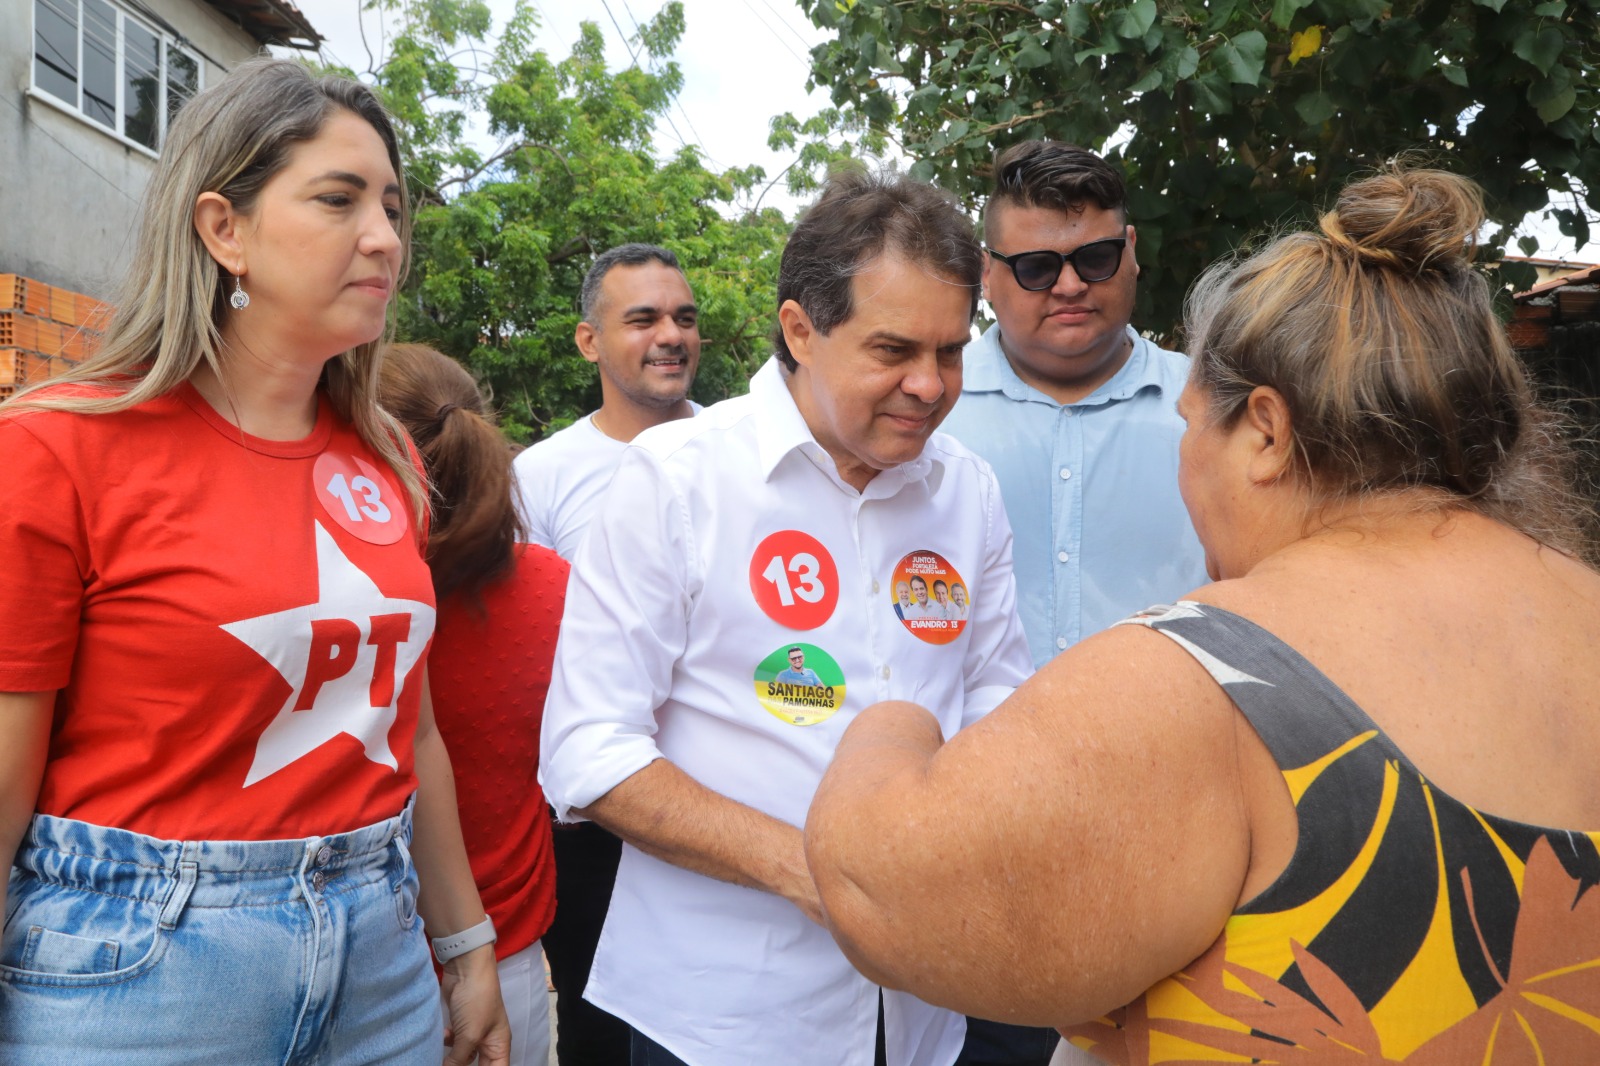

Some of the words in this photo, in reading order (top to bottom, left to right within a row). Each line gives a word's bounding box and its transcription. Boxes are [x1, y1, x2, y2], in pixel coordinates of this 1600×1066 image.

[326, 473, 391, 523] 13
[762, 553, 824, 607] 13
[292, 613, 411, 711] PT
[768, 682, 834, 698] SANTIAGO
[783, 697, 834, 708] PAMONHAS
